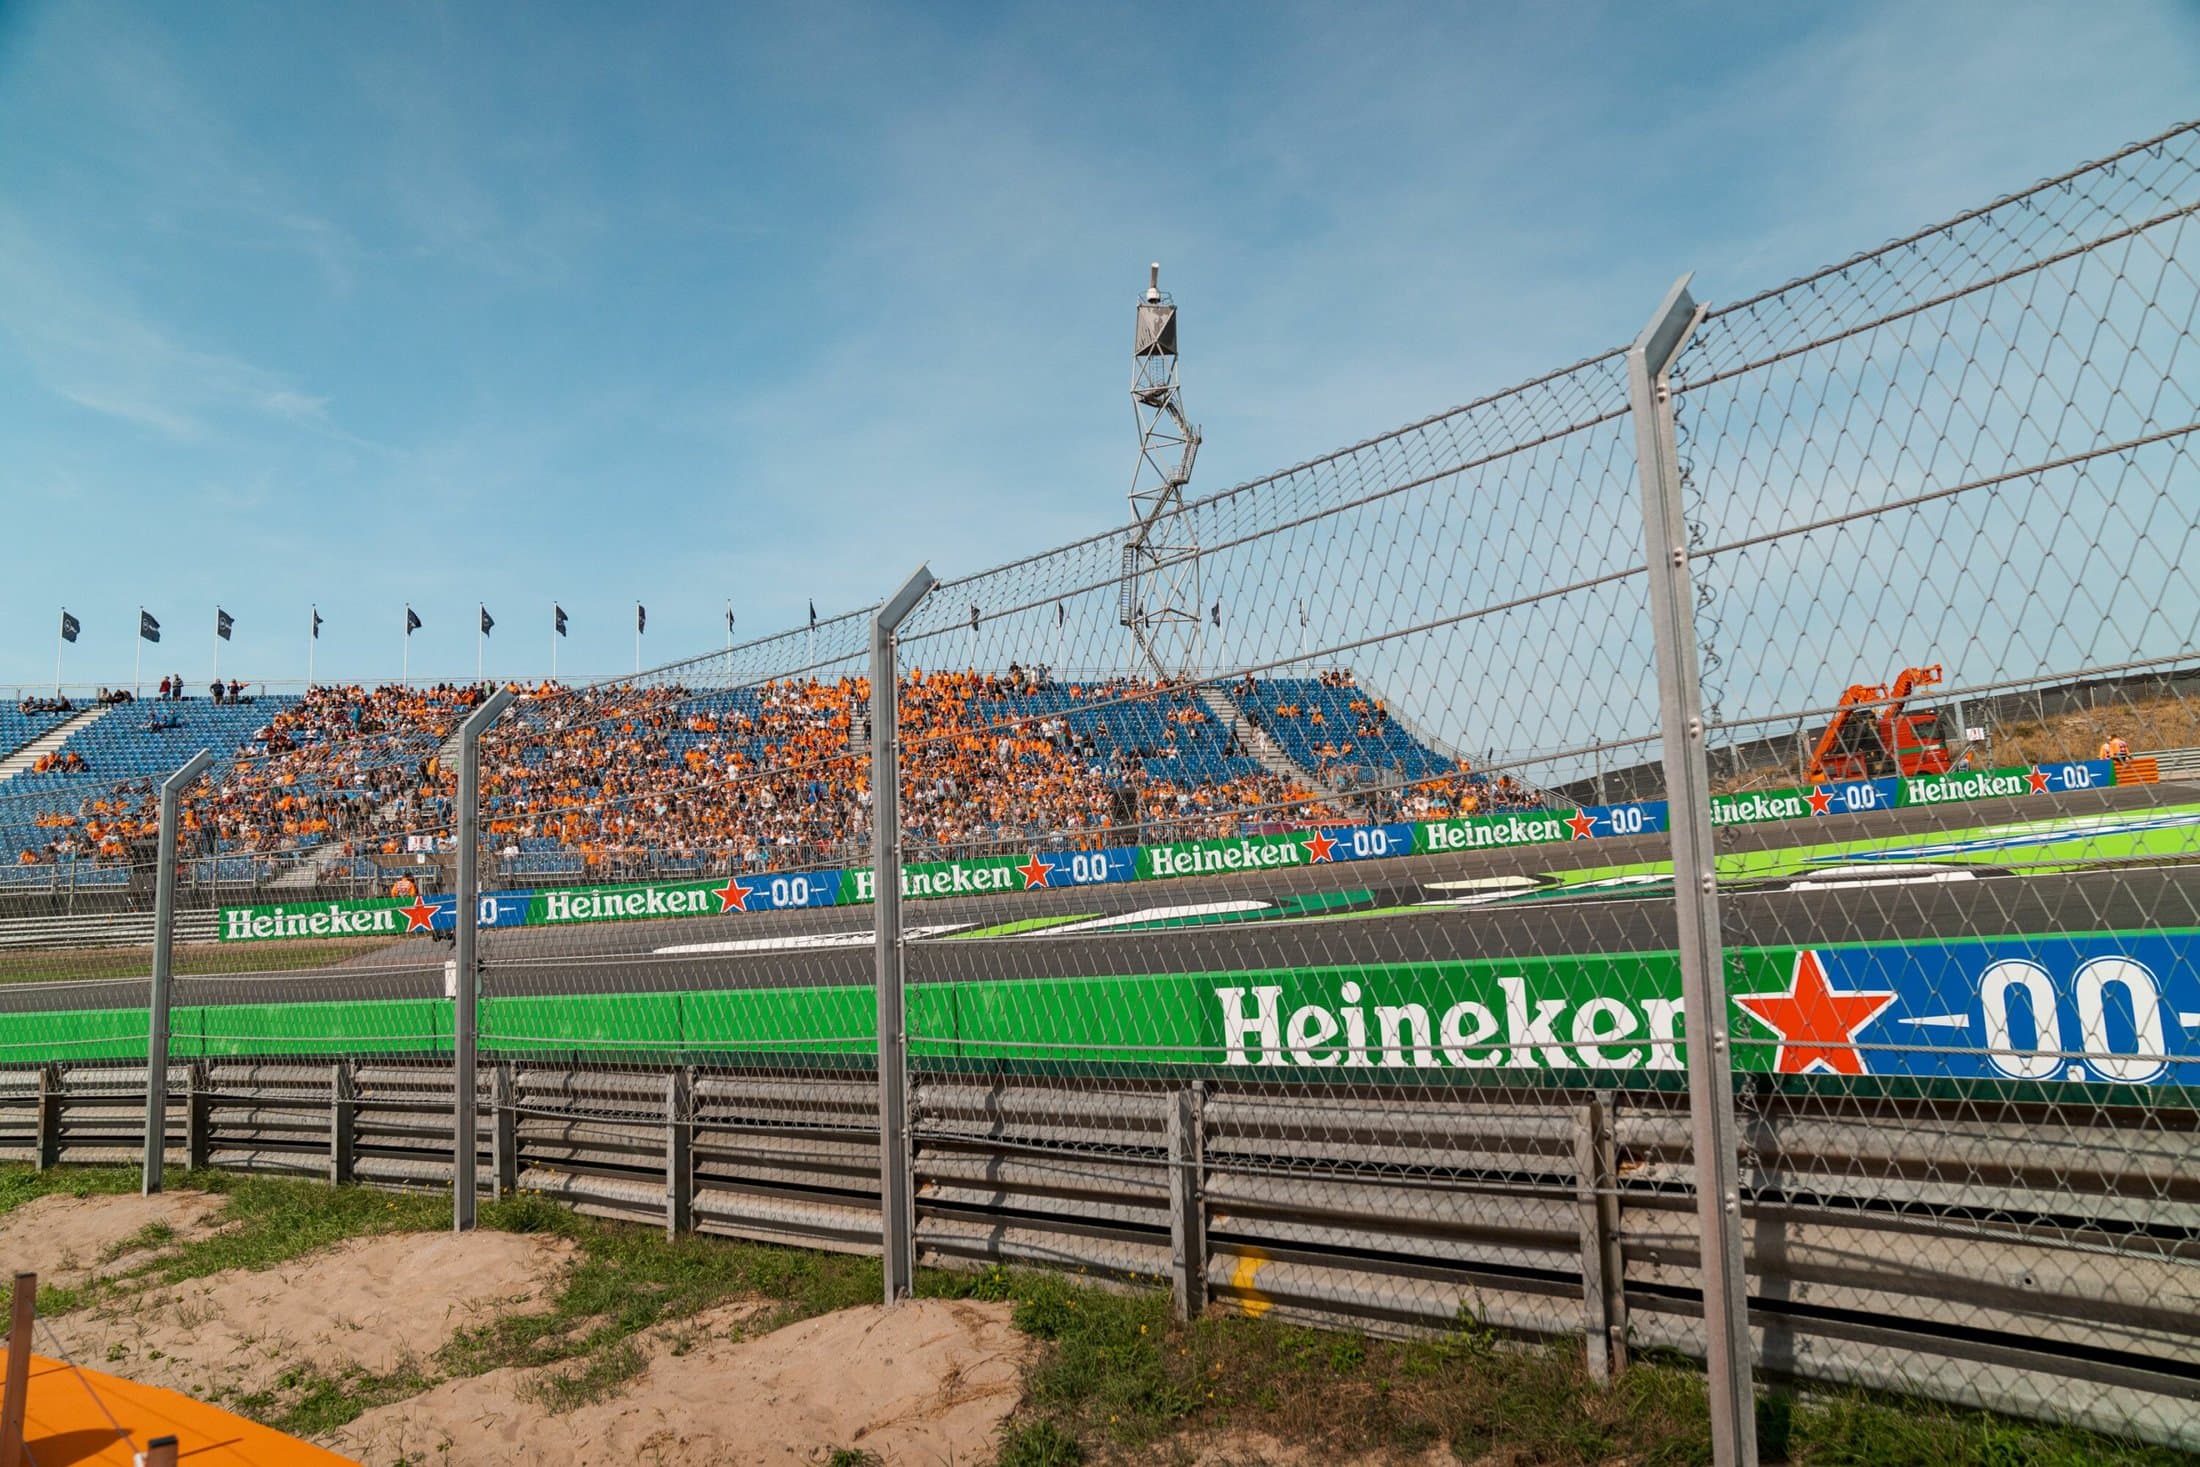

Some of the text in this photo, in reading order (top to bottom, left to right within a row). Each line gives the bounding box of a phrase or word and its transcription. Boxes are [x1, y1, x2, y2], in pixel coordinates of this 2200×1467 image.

[1909, 773, 2022, 803] Heineken
[1710, 795, 1802, 823] ineken
[1427, 817, 1562, 849] Heineken
[1151, 841, 1299, 875] Heineken
[855, 864, 1012, 899] Hineken
[546, 888, 708, 920] Heineken
[226, 904, 395, 938] Heineken
